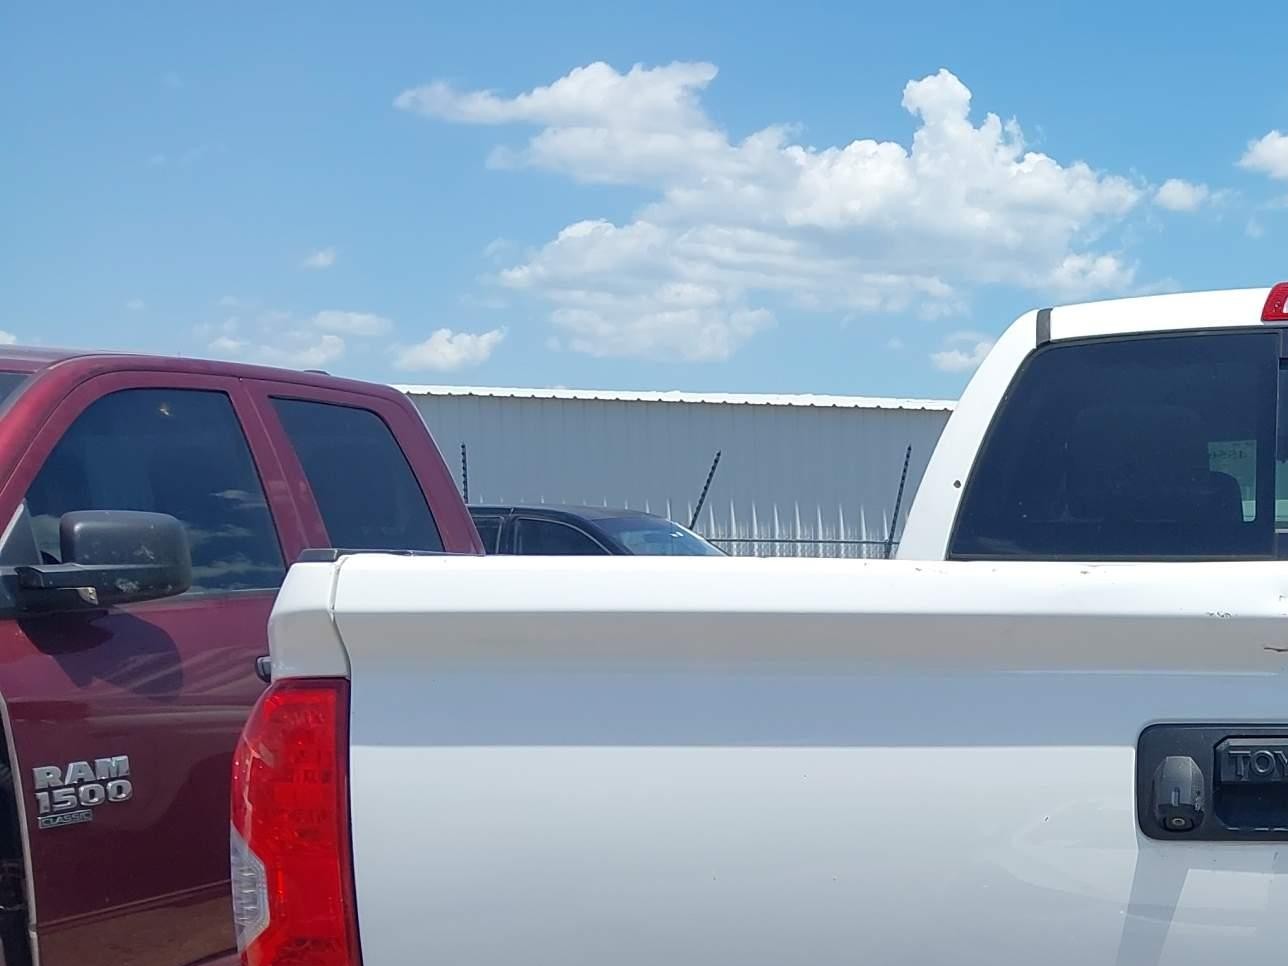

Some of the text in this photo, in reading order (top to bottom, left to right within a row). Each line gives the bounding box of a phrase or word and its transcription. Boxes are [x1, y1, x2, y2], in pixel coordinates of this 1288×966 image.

[32, 755, 130, 790] RAM
[35, 779, 133, 814] 1500
[40, 811, 92, 828] CLASSIC
